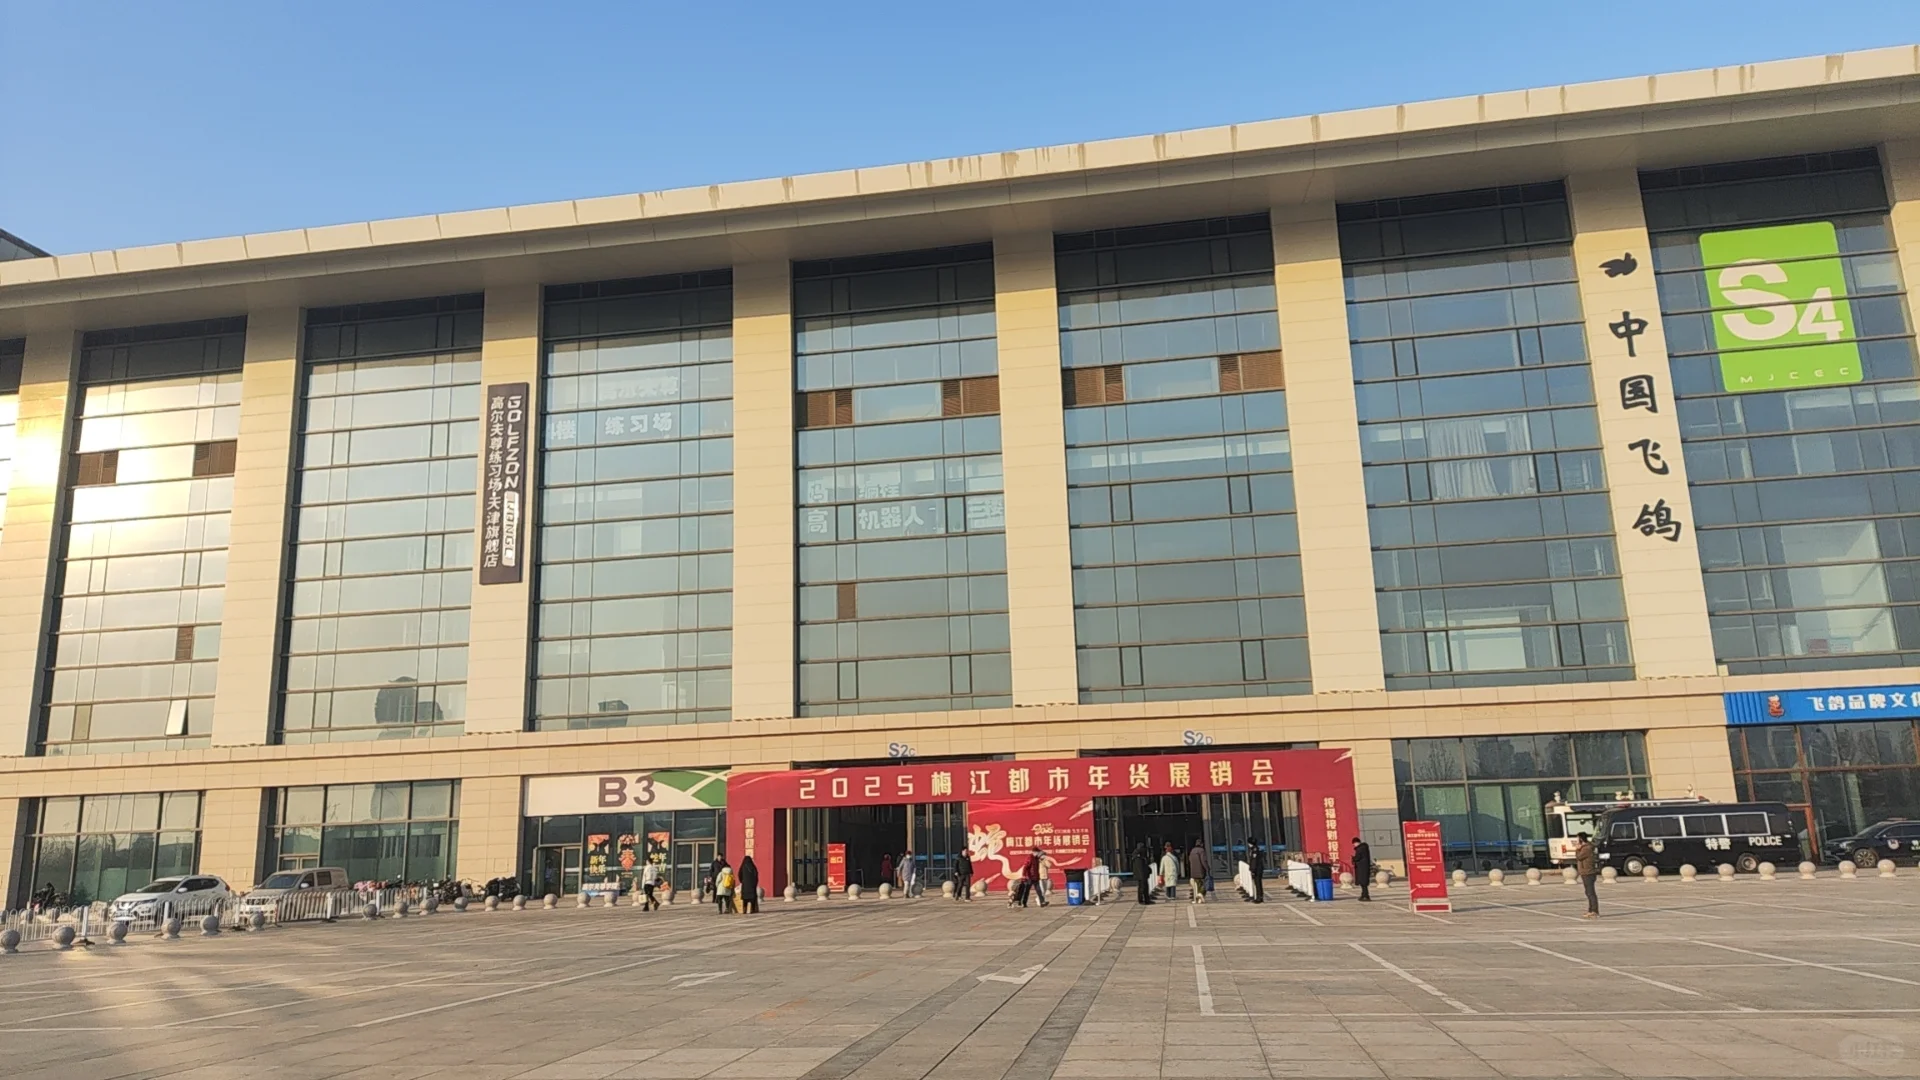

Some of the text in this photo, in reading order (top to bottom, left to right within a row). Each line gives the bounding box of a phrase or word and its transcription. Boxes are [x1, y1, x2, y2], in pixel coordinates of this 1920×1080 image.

[1718, 258, 1844, 341] S4
[1740, 366, 1850, 384] MJCEC
[605, 412, 672, 435] 练习场
[1608, 310, 1682, 542] 中国飞鸽
[504, 395, 523, 489] GOLFZON
[859, 506, 924, 531] 机器人
[598, 774, 656, 808] B3
[1705, 838, 1732, 851] 特警
[1748, 836, 1783, 847] POLICE
[590, 855, 606, 865] 新年
[590, 865, 607, 873] 快乐
[829, 856, 843, 864] 出口
